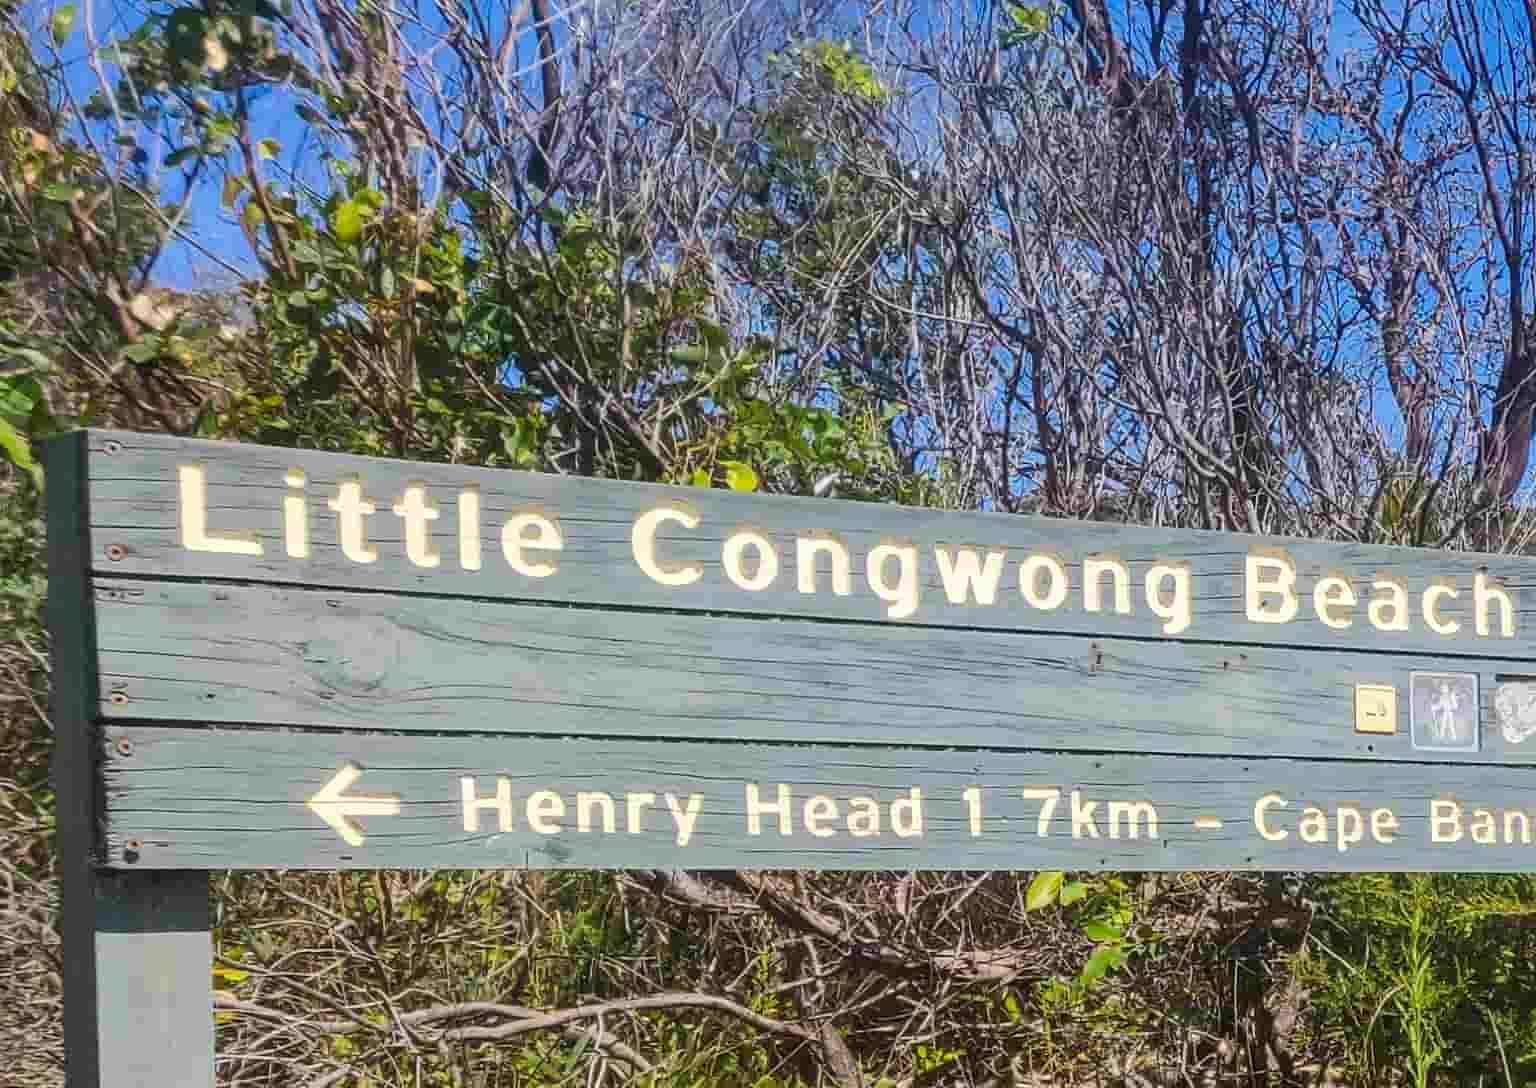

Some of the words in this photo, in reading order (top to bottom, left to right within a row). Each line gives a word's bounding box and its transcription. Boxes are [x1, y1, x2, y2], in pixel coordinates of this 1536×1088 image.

[178, 464, 566, 579] Little
[630, 506, 1192, 636] Congwong
[1245, 554, 1516, 638] Beach
[461, 777, 706, 848] Henry
[744, 782, 925, 840] Head
[1252, 793, 1402, 853] Cape
